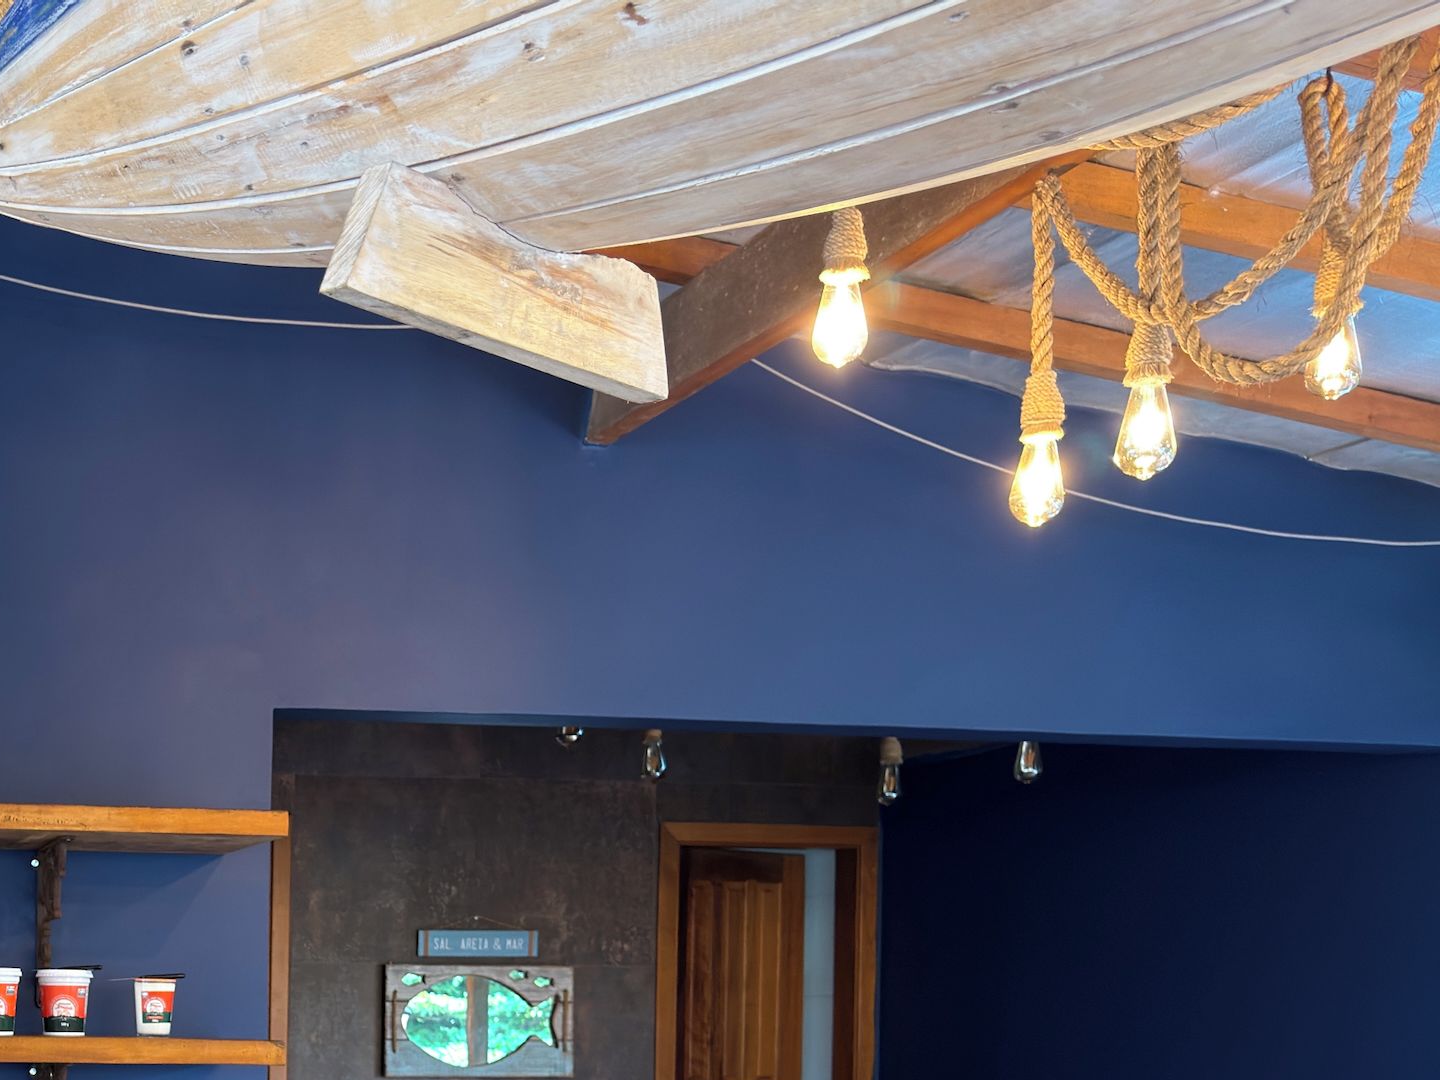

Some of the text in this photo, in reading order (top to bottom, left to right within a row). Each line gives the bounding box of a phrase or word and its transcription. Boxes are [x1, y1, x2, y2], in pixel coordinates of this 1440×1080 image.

[460, 937, 489, 950] AREIA
[492, 937, 502, 950] &
[506, 937, 524, 950] MAR
